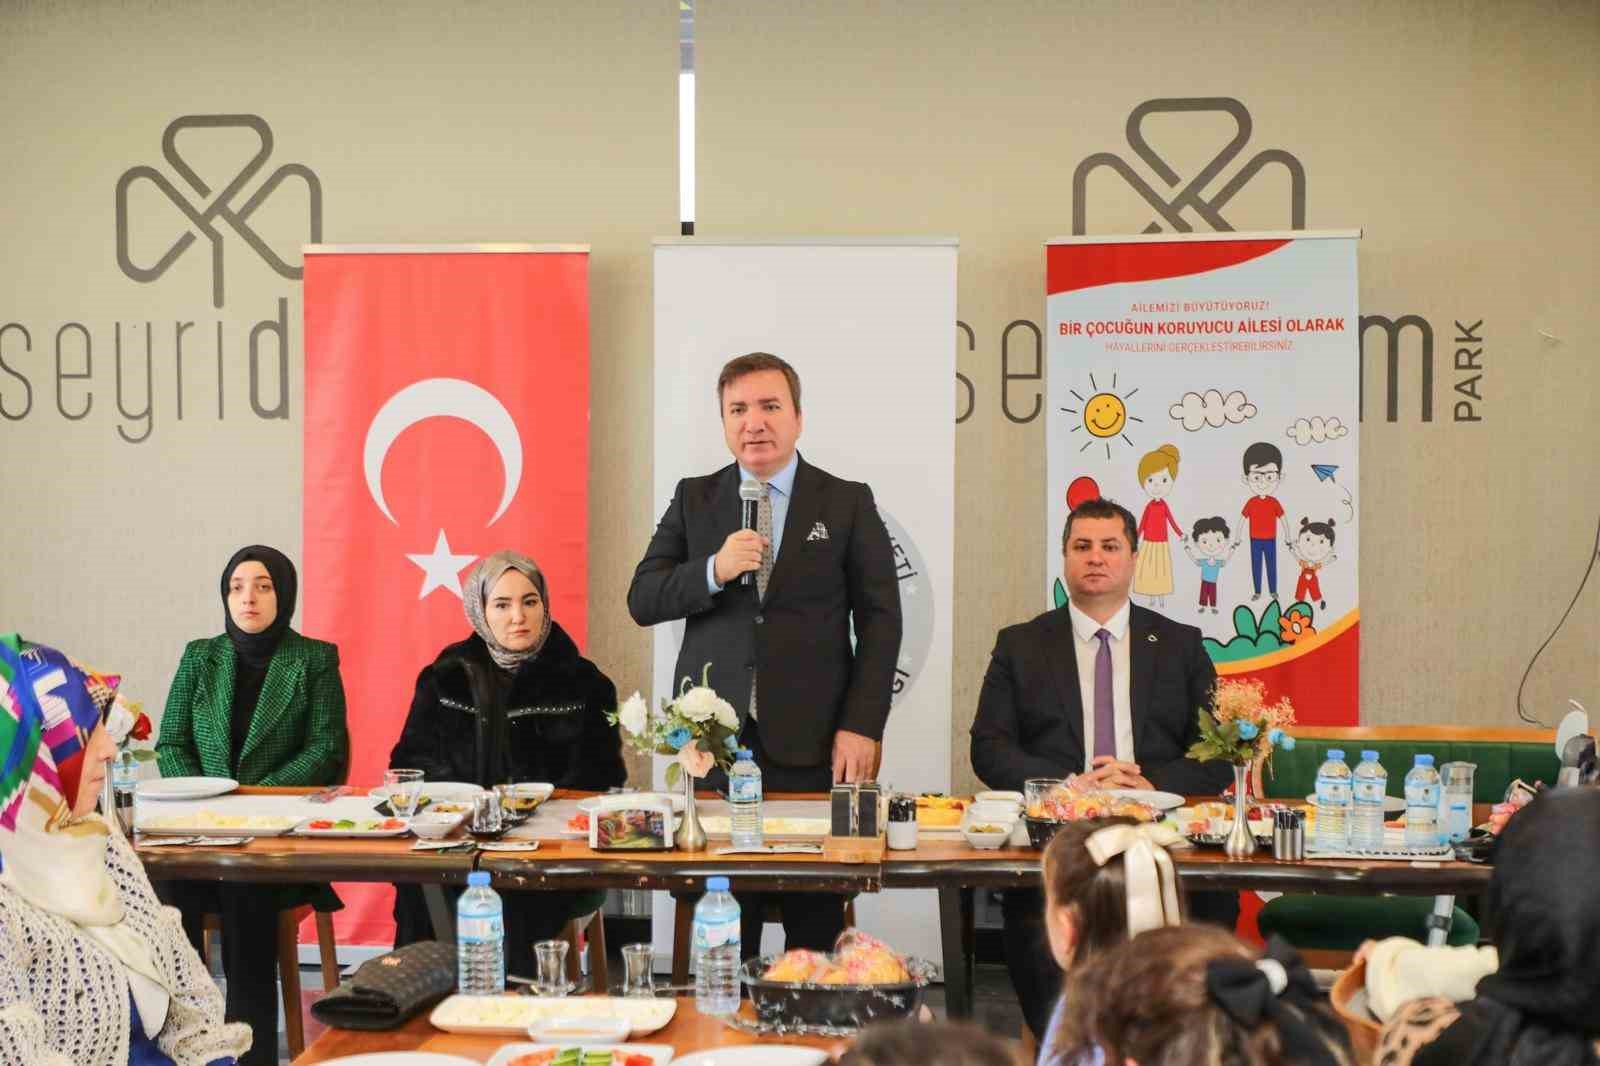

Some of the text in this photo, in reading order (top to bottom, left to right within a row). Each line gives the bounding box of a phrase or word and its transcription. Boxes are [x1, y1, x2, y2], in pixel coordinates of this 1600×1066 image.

[0, 297, 289, 443] seyrid
[1059, 316, 1345, 338] BİR ÇOCUĞUN KORUYUCU AİLESİ OLARAK
[1454, 319, 1483, 422] PARK
